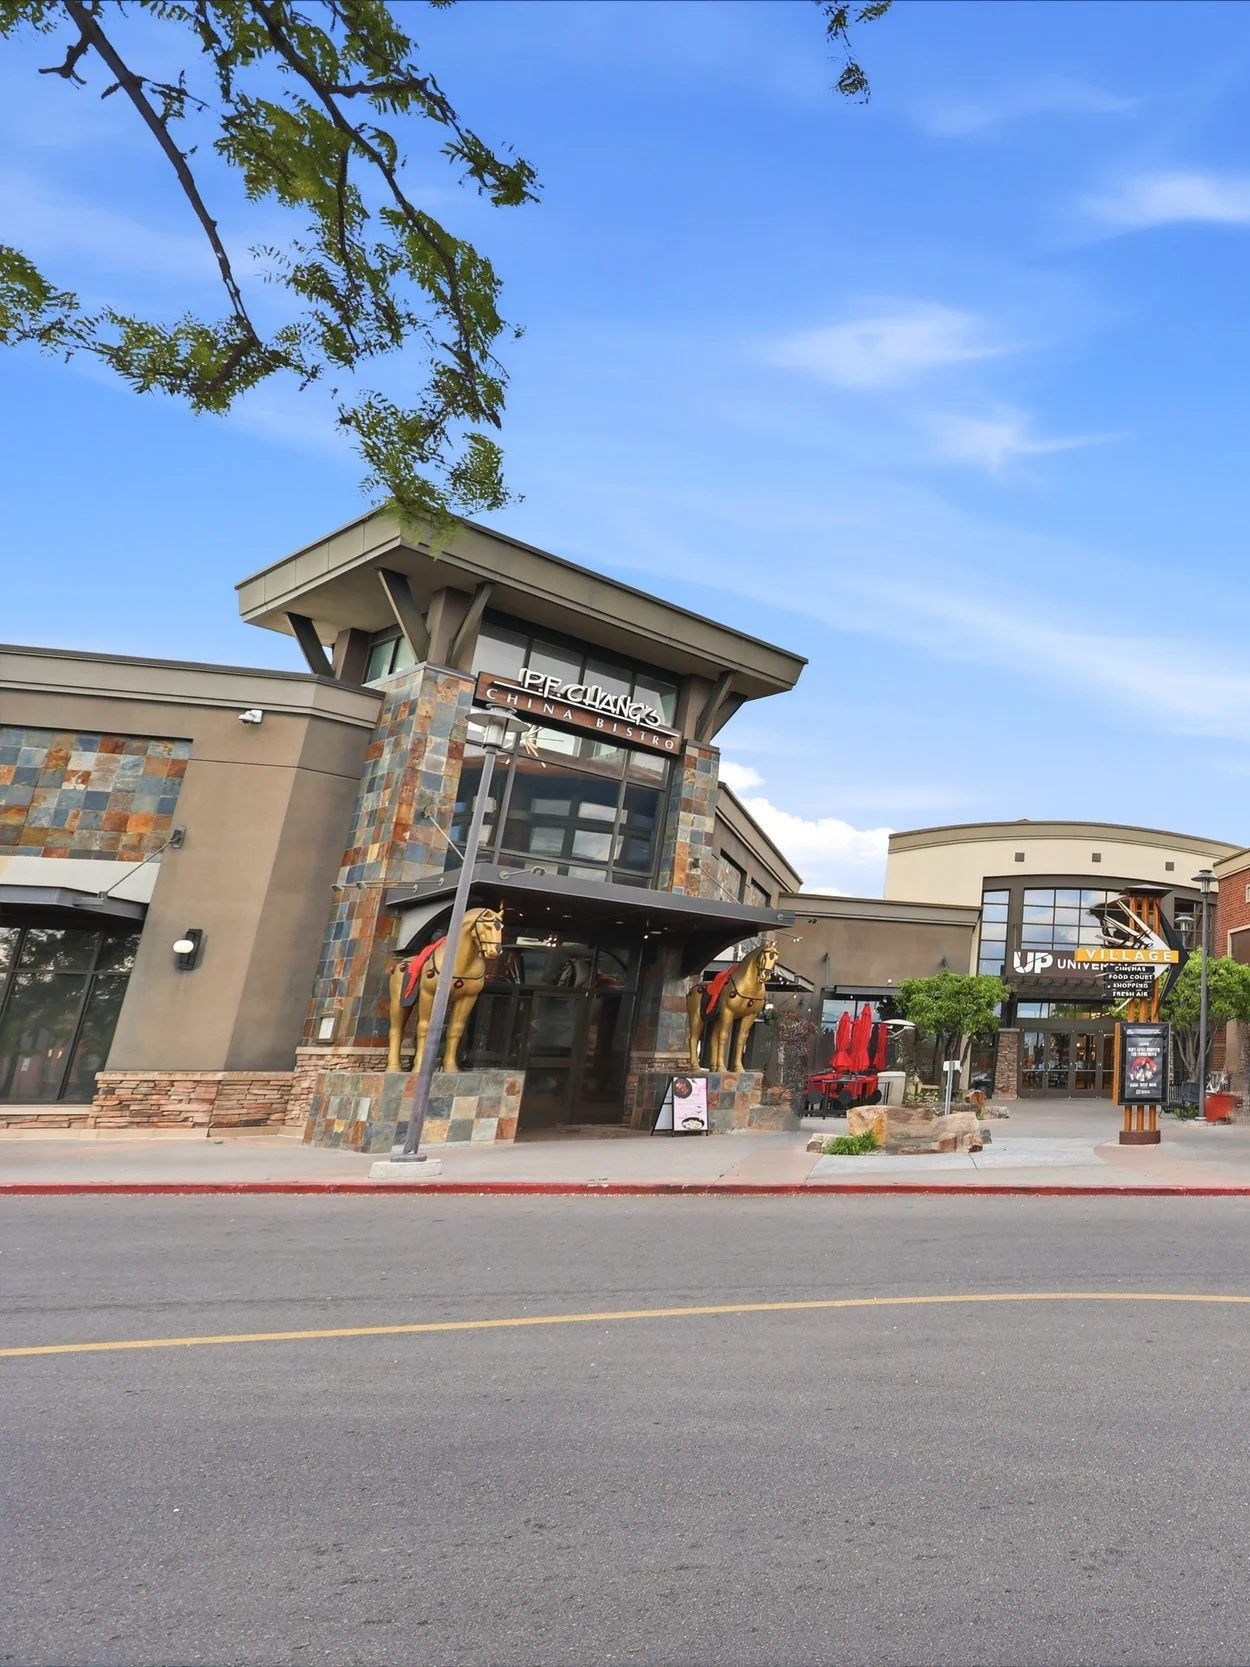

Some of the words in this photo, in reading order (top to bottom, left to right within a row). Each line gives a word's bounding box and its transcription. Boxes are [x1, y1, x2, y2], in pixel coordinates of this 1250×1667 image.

[485, 688, 574, 720] CHINA
[595, 716, 675, 750] BISTRO
[1013, 952, 1053, 974] UP
[1086, 948, 1173, 961] VILLAGE
